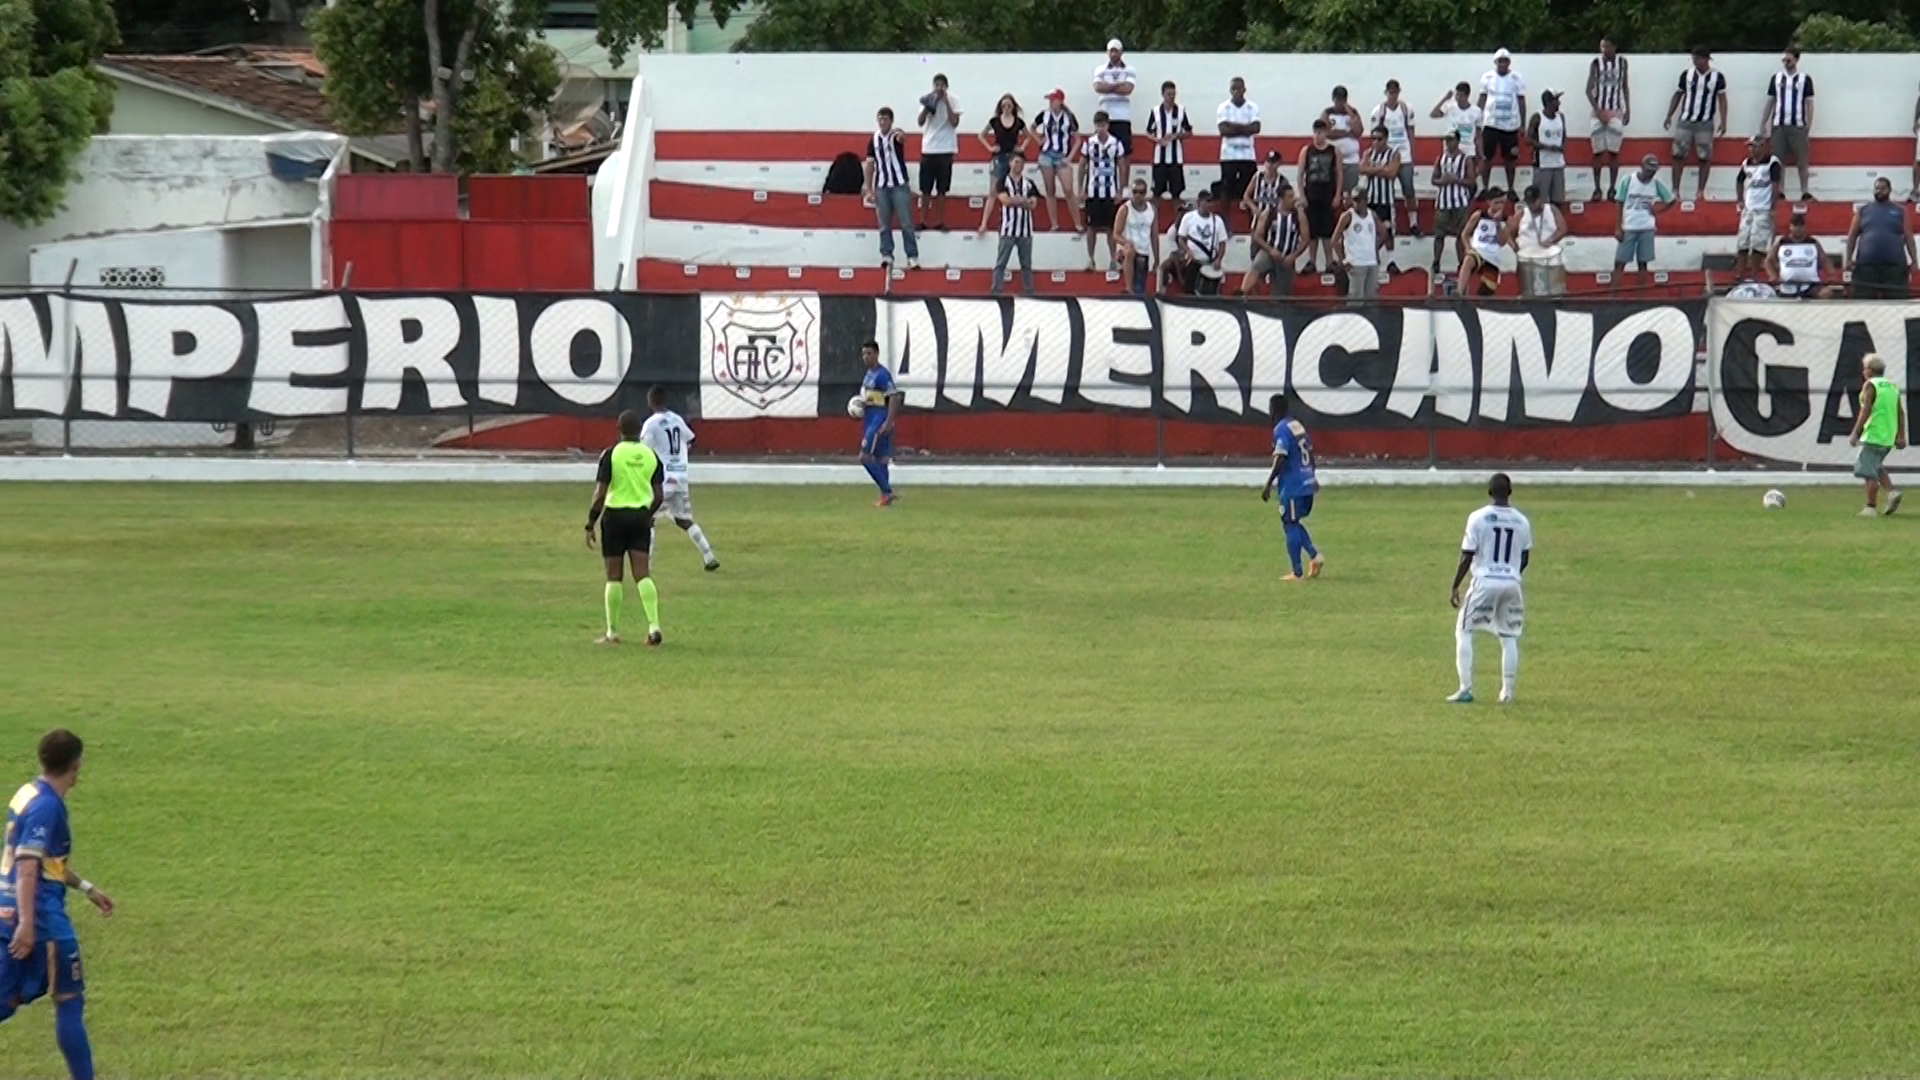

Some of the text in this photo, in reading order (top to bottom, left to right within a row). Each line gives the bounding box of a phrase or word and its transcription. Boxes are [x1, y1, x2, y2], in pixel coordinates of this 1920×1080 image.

[874, 297, 1696, 423] AMERICANO
[1720, 316, 1920, 445] GA
[664, 426, 681, 455] 10
[1493, 527, 1514, 564] 11
